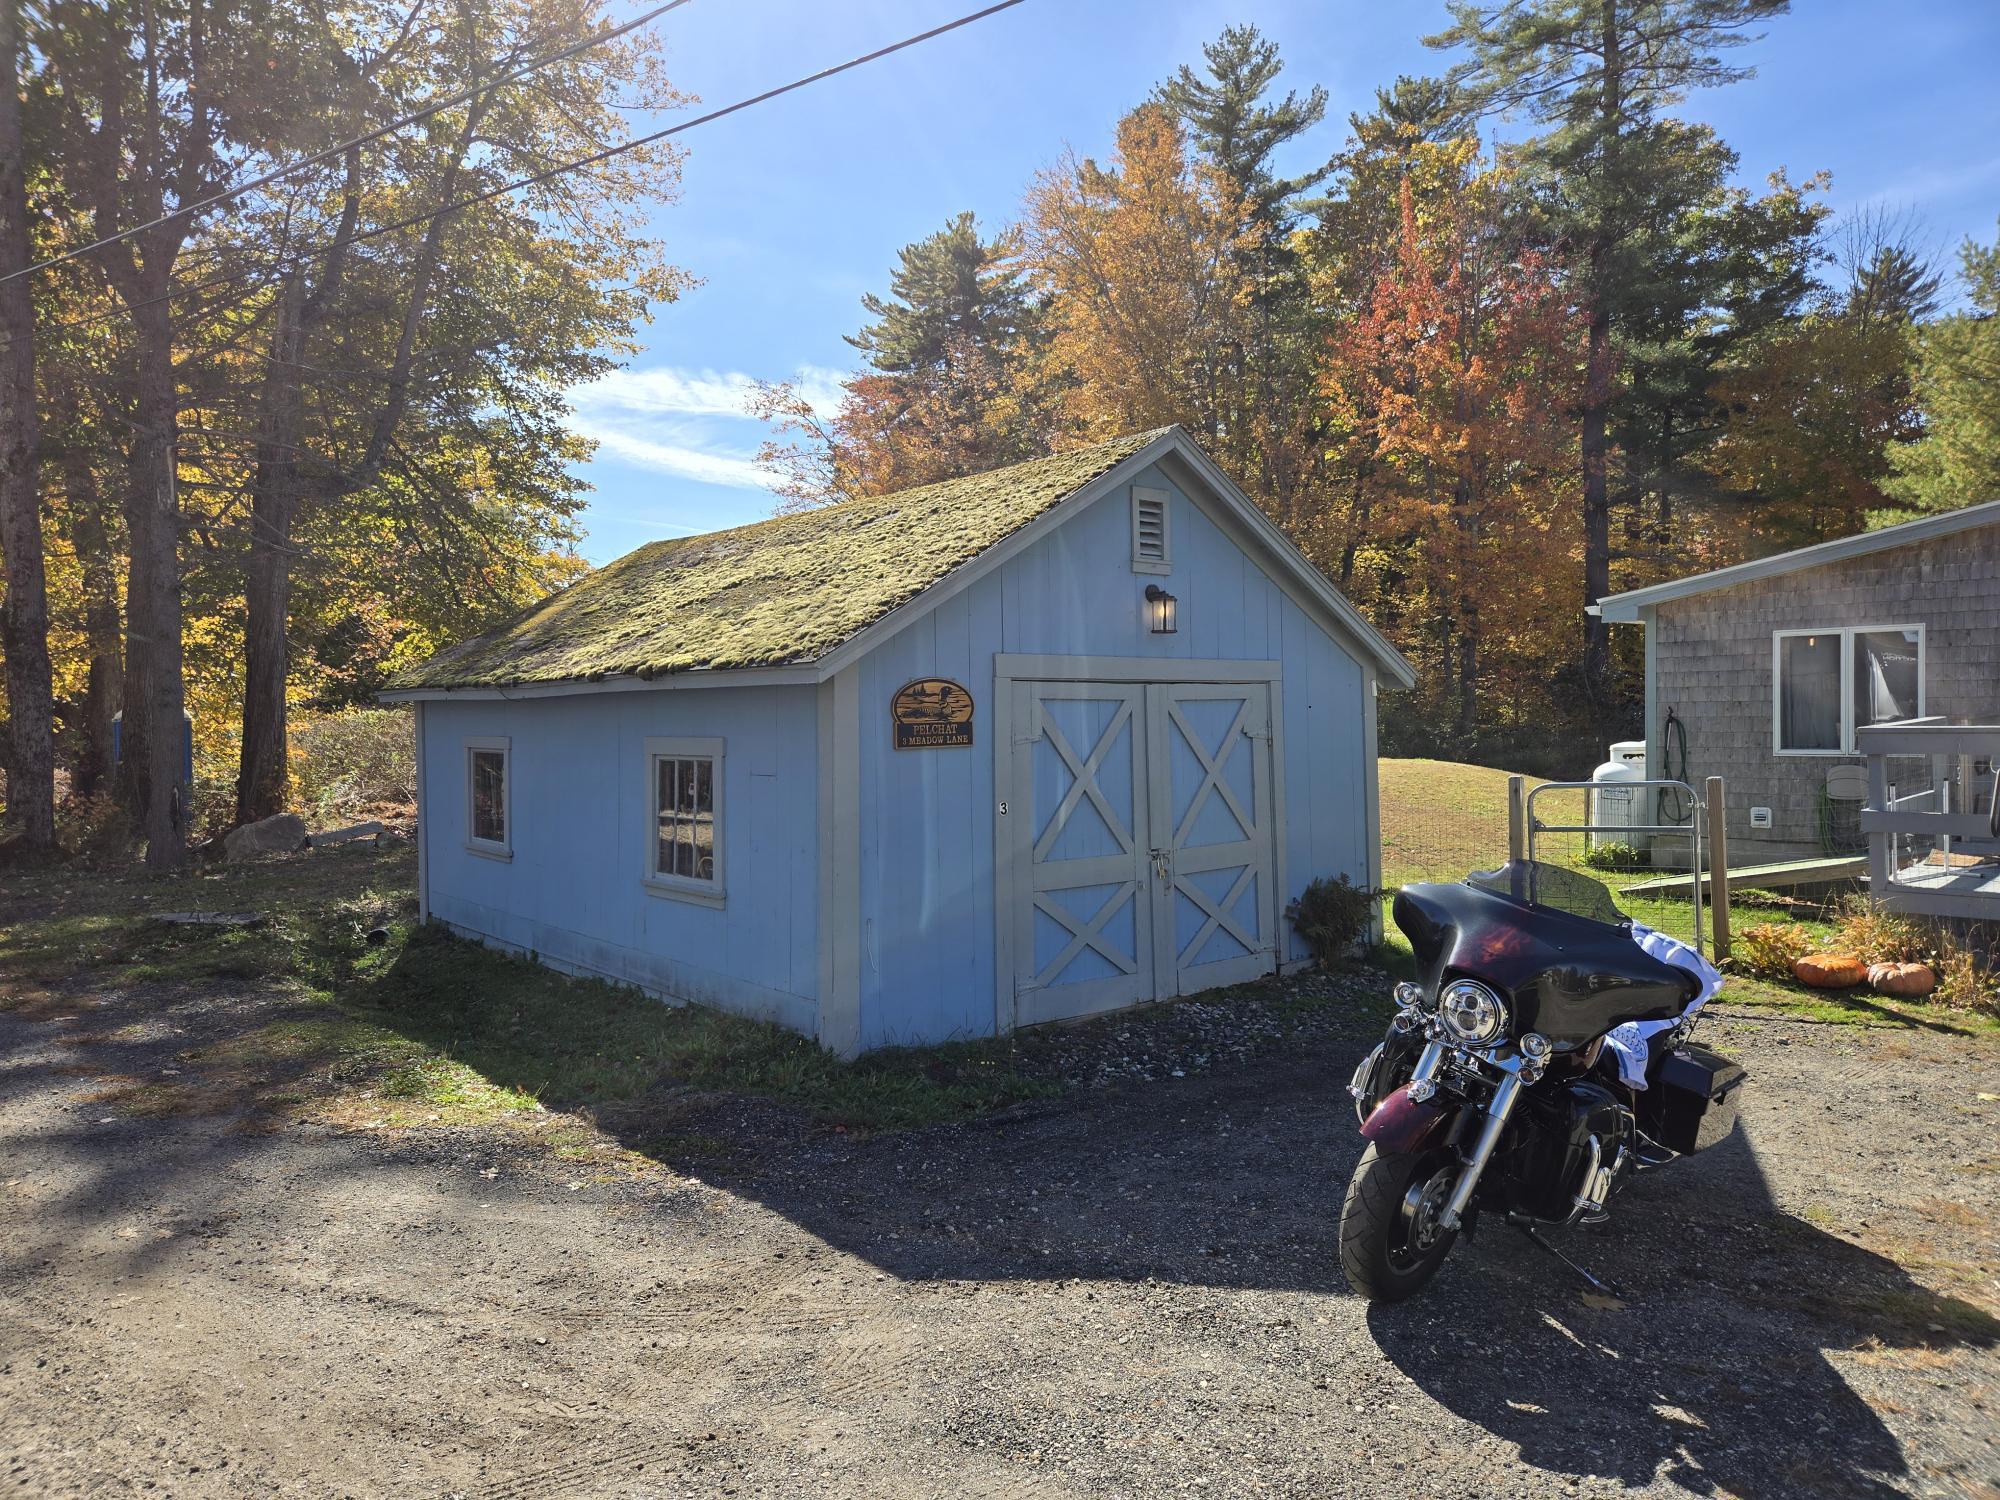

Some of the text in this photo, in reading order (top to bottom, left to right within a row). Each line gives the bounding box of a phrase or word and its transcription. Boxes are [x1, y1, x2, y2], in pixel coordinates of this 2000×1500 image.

[913, 724, 958, 735] PELCHAT
[902, 735, 969, 745] 3 MEADOW LANE
[1000, 802, 1008, 815] 3
